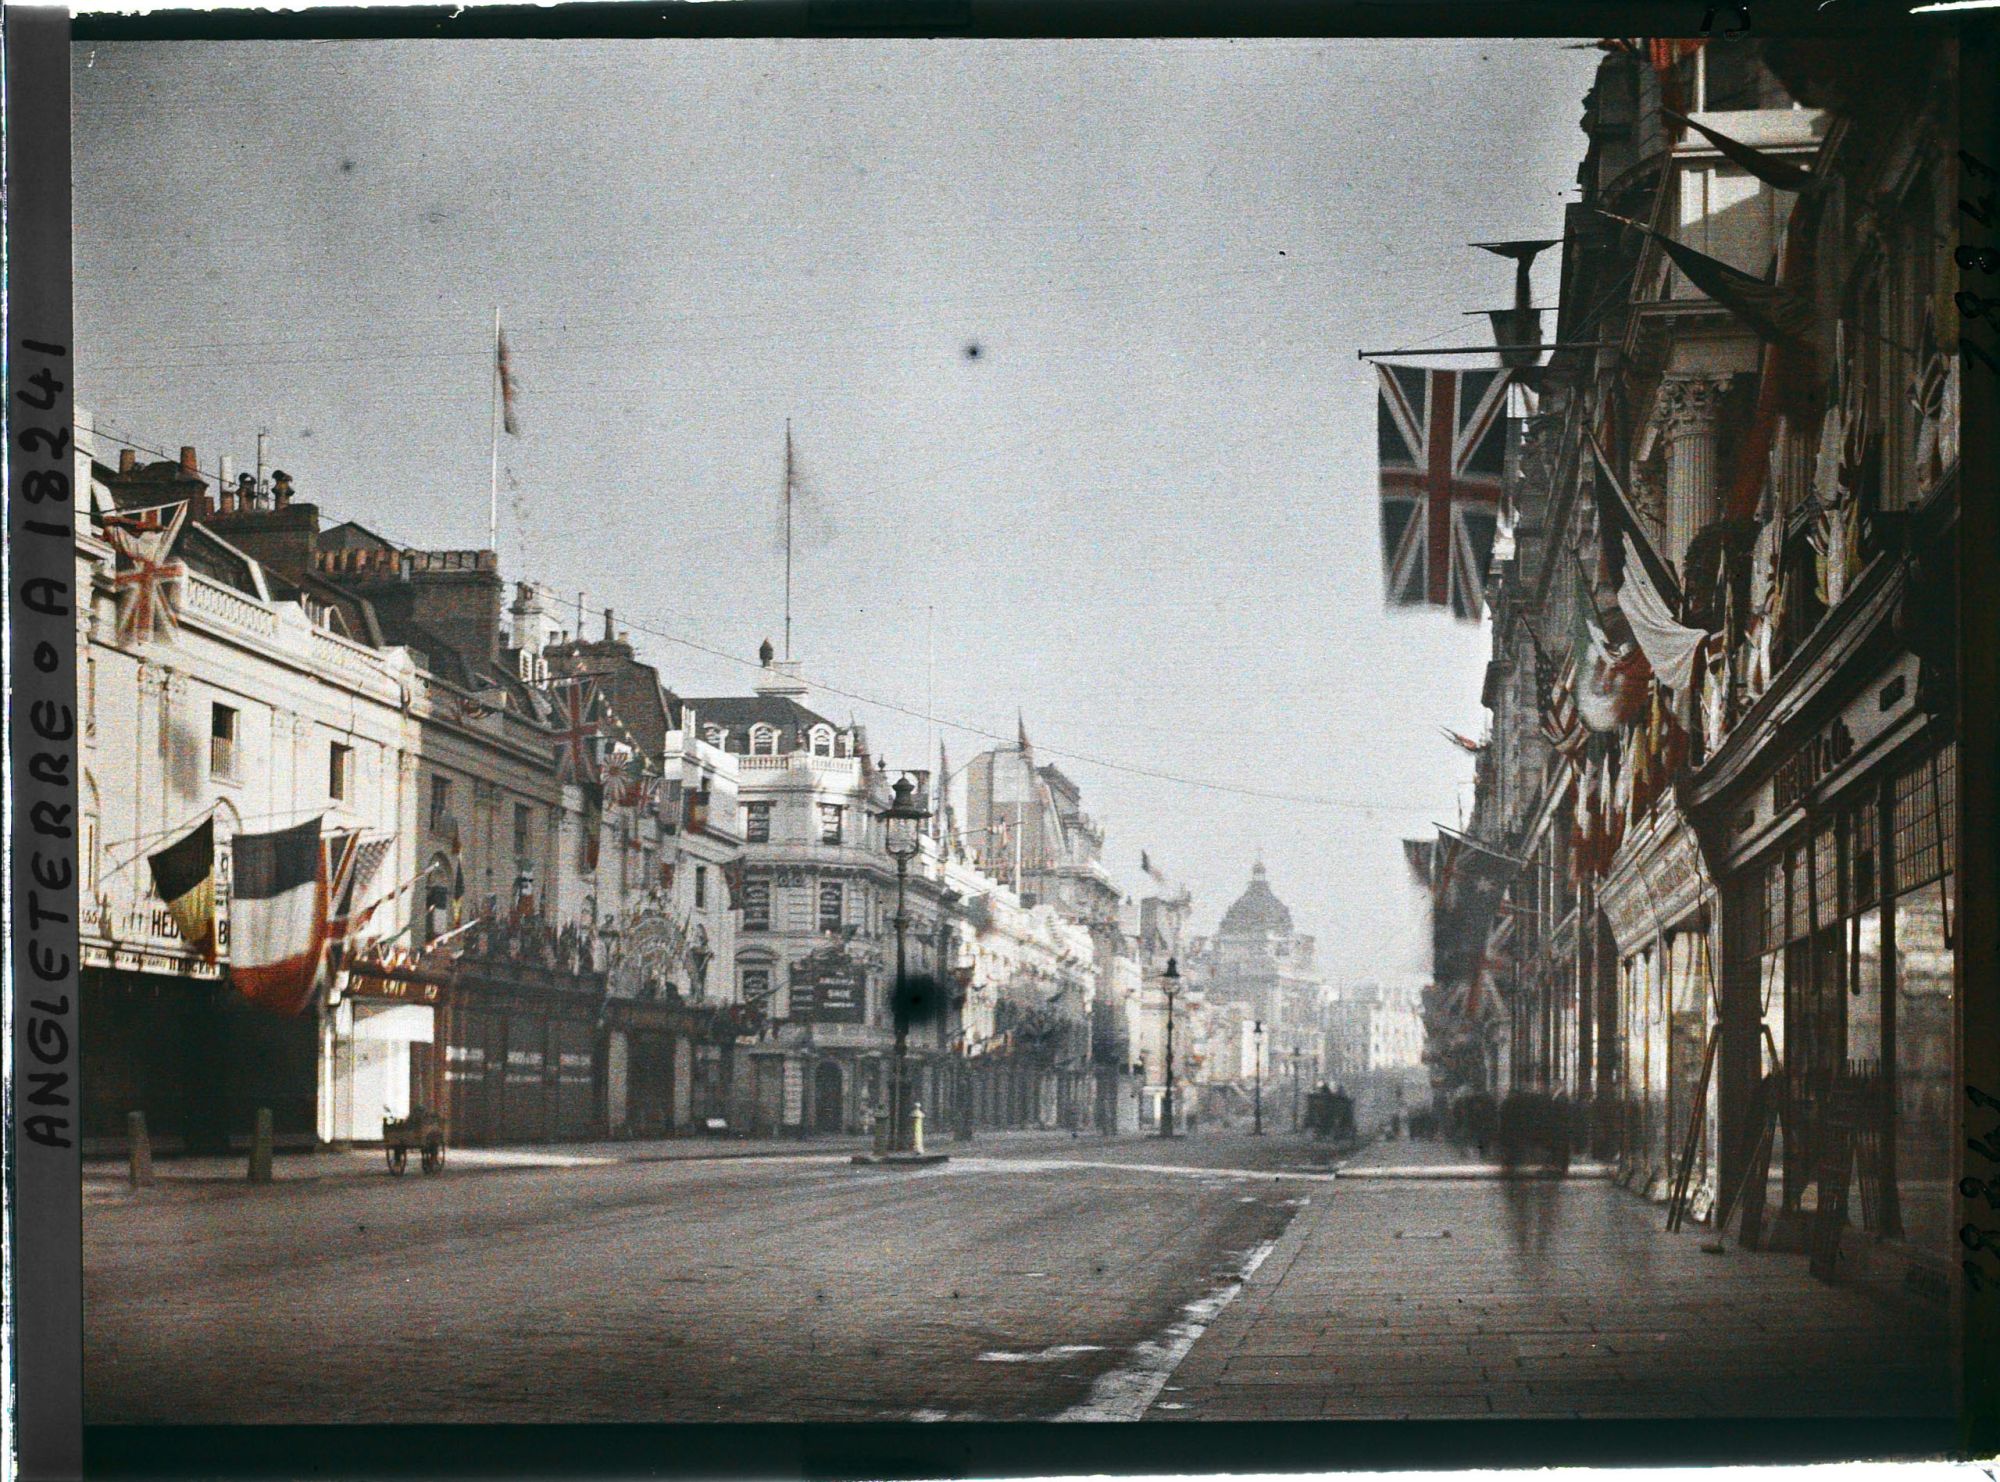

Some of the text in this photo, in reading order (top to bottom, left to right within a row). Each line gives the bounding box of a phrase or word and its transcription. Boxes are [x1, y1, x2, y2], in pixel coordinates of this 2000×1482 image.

[17, 339, 72, 538] 18241
[21, 577, 70, 616] A
[24, 700, 74, 1148] ANGLETERRE
